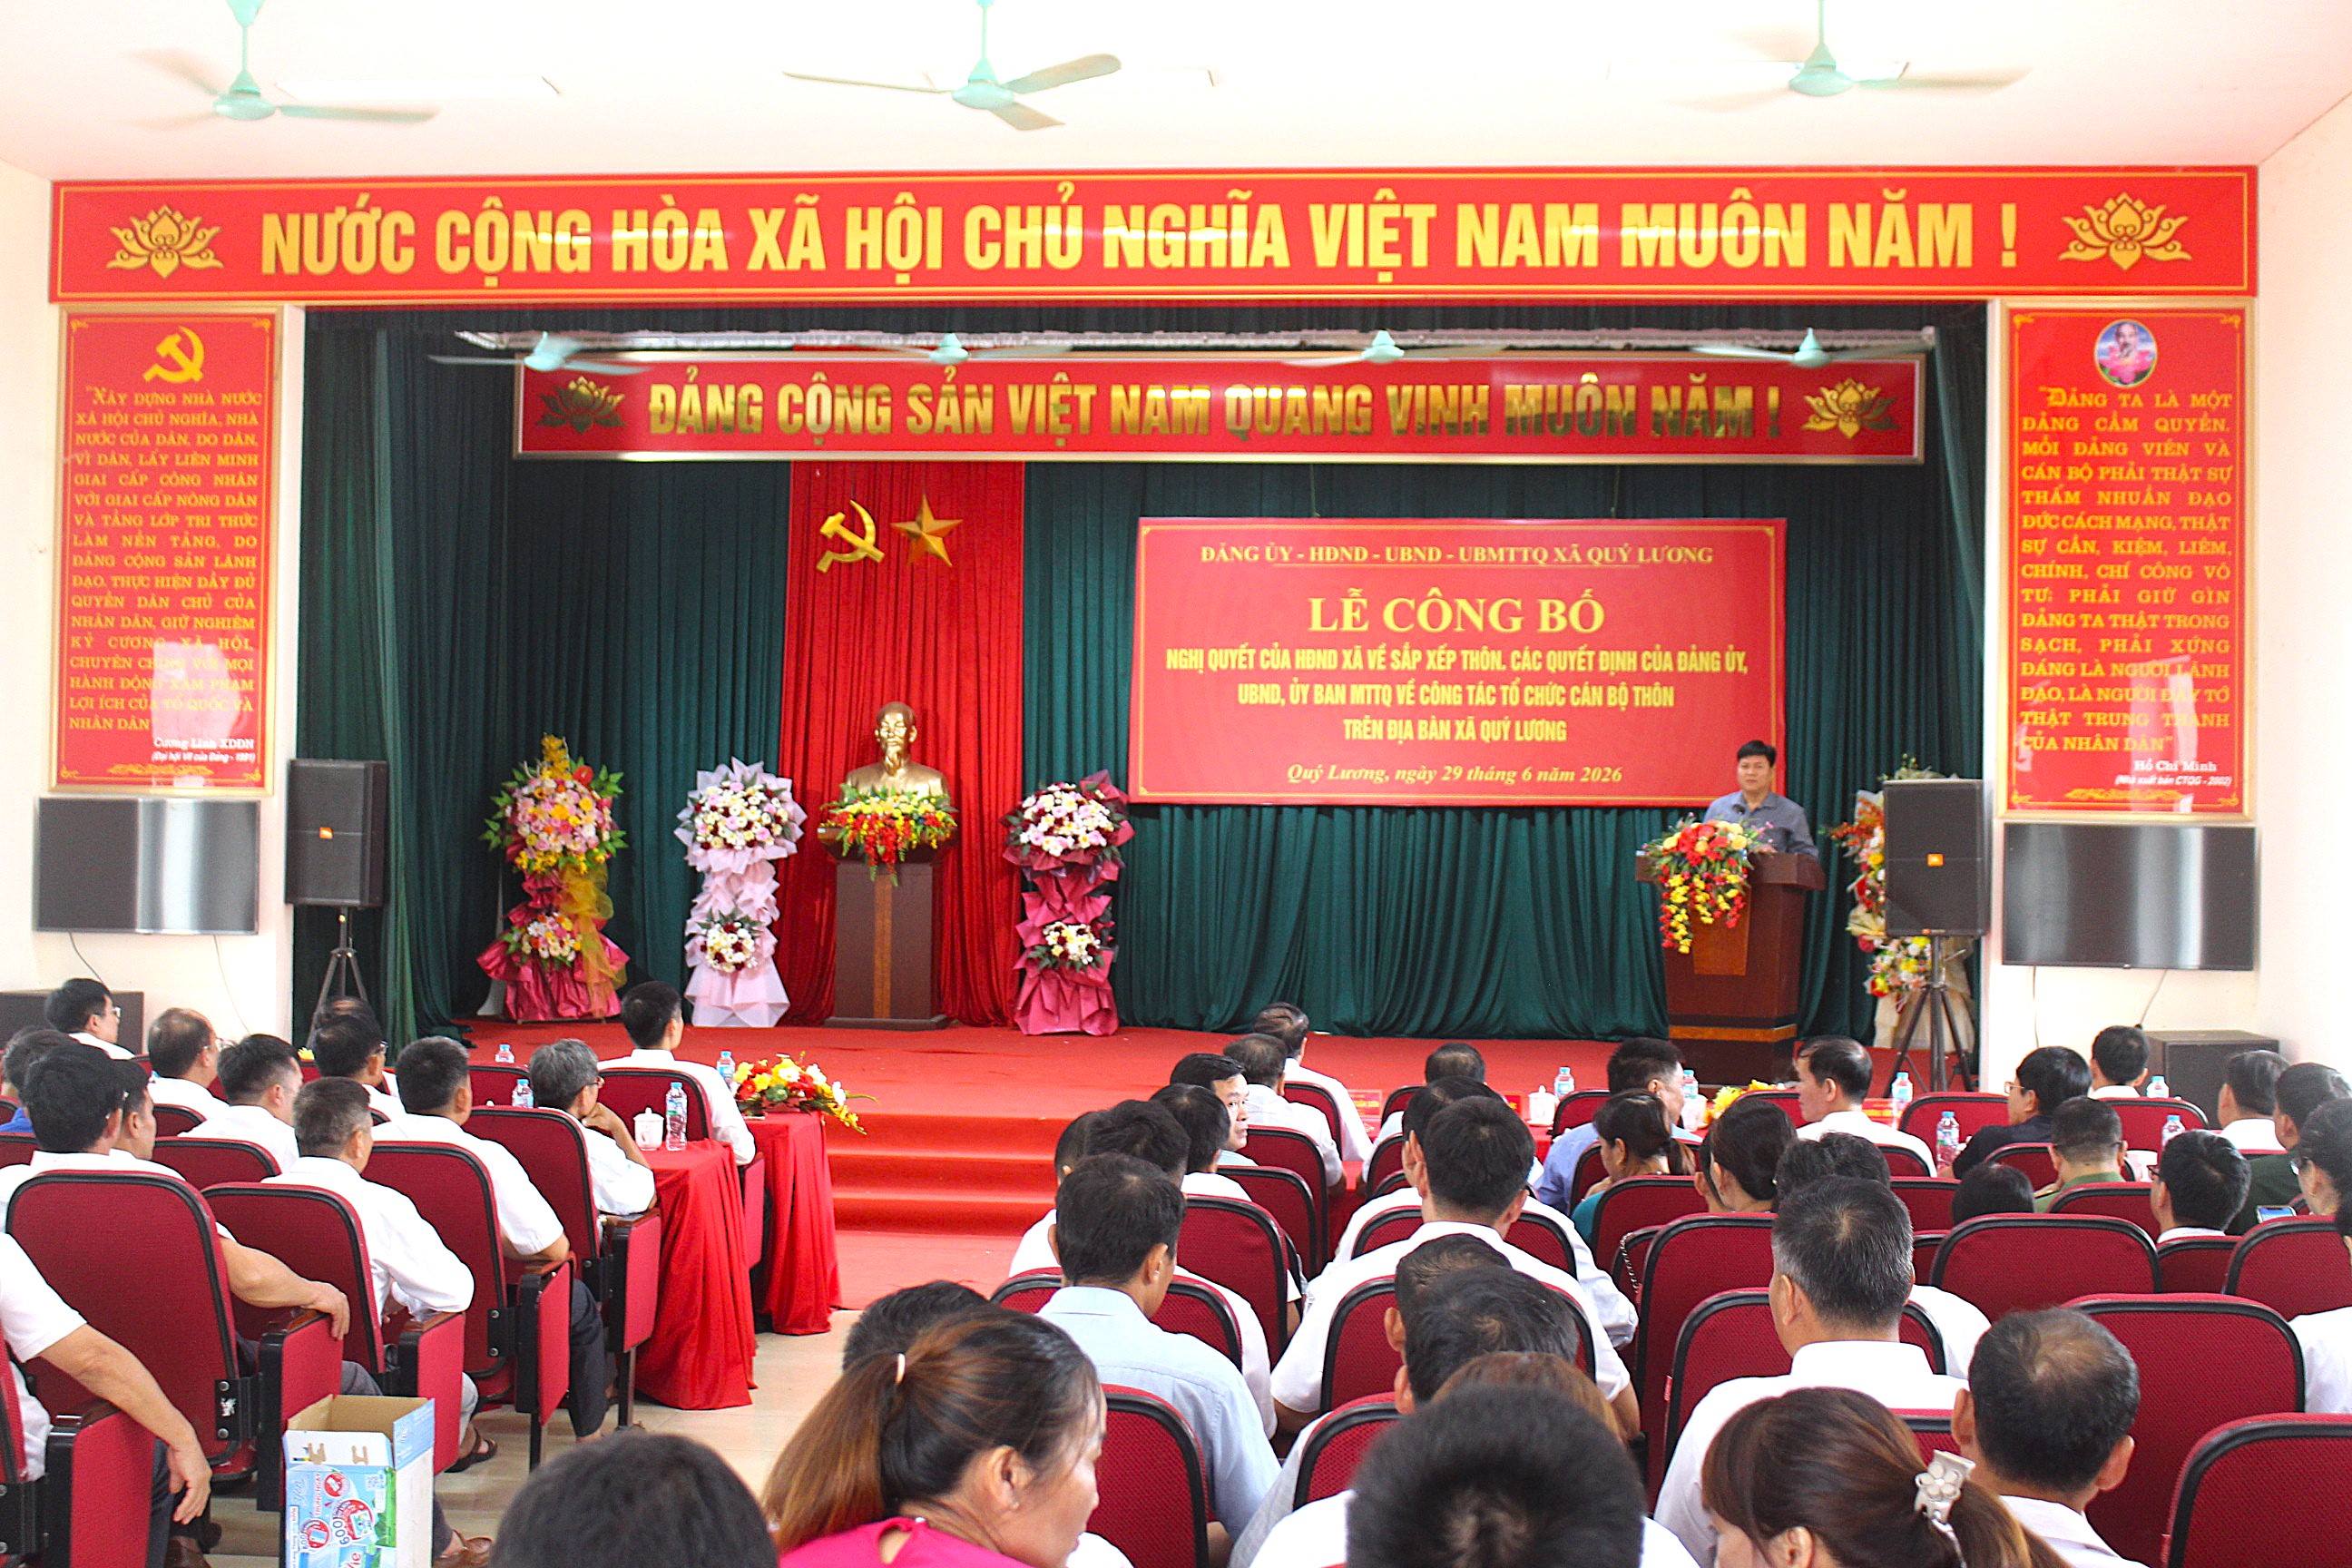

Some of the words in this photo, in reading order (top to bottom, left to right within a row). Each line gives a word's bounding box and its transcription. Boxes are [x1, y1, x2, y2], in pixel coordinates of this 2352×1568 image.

[262, 192, 415, 275] NƯỚC
[436, 195, 591, 287] CỘNG
[612, 194, 728, 272] HÒA
[748, 193, 826, 270] XÃ
[846, 191, 942, 285] HỘI
[964, 181, 1084, 270] CHỦ
[1103, 189, 1290, 270] NGHĨA
[1308, 188, 1437, 283] VIỆT
[1456, 202, 1599, 268] NAM
[1621, 187, 1807, 268] MUÔN
[1828, 188, 1974, 268] NĂM
[2001, 202, 2017, 268] !
[649, 366, 764, 436] ĐẢNG
[778, 372, 894, 446] CỘNG
[907, 366, 995, 436] SẢN
[1007, 372, 1098, 446] VIỆT
[1110, 385, 1211, 436] NAM
[1225, 385, 1373, 441] QUANG
[1386, 385, 1490, 436] VINH
[1504, 372, 1638, 437] MUÔN
[1651, 372, 1755, 438] NĂM
[1768, 386, 1781, 439] !
[2118, 394, 2142, 407] TA
[2154, 393, 2179, 407] LÀ
[2191, 392, 2231, 410] MỘT
[2023, 411, 2080, 431] ĐẢNG
[2093, 413, 2139, 432] CẦM
[2073, 436, 2128, 456] ĐẢNG
[2143, 440, 2189, 456] VIÊN
[2204, 443, 2230, 456] VÀ
[2022, 462, 2062, 480] CÁN
[2067, 463, 2094, 483] BỘ
[2099, 462, 2144, 480] PHẢI
[2151, 463, 2201, 483] THẬT
[2208, 466, 2233, 482] SỰ
[2022, 485, 2082, 505] THẤM
[2097, 486, 2171, 505] NHUẦN
[2188, 491, 2231, 508] ĐẠO
[2022, 511, 2059, 530] ĐỨC
[2062, 511, 2112, 530] CÁCH
[2181, 514, 2230, 532] THẬT
[1201, 544, 1259, 563] ĐẢNG
[1265, 542, 1292, 562] ỦY
[1309, 546, 1368, 562] HĐND
[1386, 546, 1442, 562] UBND
[1459, 546, 1548, 565] UBMTTQ
[1553, 544, 1582, 563] XÃ
[1637, 545, 1713, 564] LƯƠNG
[2096, 563, 2130, 579] CHÍ
[2140, 563, 2192, 579] CÔNG
[2205, 564, 2230, 580] VÔ
[2069, 584, 2120, 603] PHẢI
[2137, 587, 2176, 603] GIỮ
[2191, 589, 2230, 603] GÌN
[1309, 588, 1369, 632] LỄ
[1383, 587, 1524, 633] CÔNG
[1538, 588, 1605, 633] BỐ
[2022, 607, 2075, 628] ĐẢNG
[2081, 613, 2103, 628] TA
[2110, 610, 2160, 631] THẬT
[2163, 615, 2230, 629] TRONG
[2100, 633, 2151, 653] PHẢI
[2171, 638, 2230, 653] XỨNG
[1166, 648, 1204, 674] NGHỊ
[1208, 644, 1256, 671] QUYẾT
[1260, 642, 1291, 669] CỦA
[1295, 649, 1338, 671] HĐND
[1340, 645, 1364, 671] XÃ
[1367, 644, 1387, 671] VỀ
[1390, 643, 1423, 671] SẮP
[1426, 644, 1457, 671] XẾP
[1510, 646, 1543, 671] CÁC
[1546, 644, 1596, 672] QUYẾT
[1599, 650, 1637, 676] ĐỊNH
[1642, 644, 1673, 671] CỦA
[1678, 644, 1720, 672] ĐẢNG
[2021, 659, 2075, 677] ĐÁNG
[2081, 659, 2105, 677] LÀ
[1238, 683, 1286, 707] UBND,
[1289, 678, 1310, 704] ỦY
[1313, 684, 1347, 704] BAN
[1350, 683, 1393, 706] MTTQ
[1396, 679, 1415, 705] VỀ
[1418, 681, 1464, 706] CÔNG
[1466, 682, 1496, 706] TÁC
[1500, 678, 1521, 706] TỔ
[1524, 682, 1568, 706] CHỨC
[1569, 683, 1604, 707] CÁN
[1606, 682, 1630, 710] BỘ
[1632, 682, 1675, 707] THÔN
[2020, 709, 2073, 729] THẬT
[2083, 711, 2149, 727] TRUNG
[1344, 717, 1384, 740] TRÊN
[1387, 719, 1414, 744] ĐỊA
[1418, 716, 1452, 740] BÀN
[1455, 717, 1477, 740] XÃ
[1480, 718, 1511, 743] QUÝ
[1513, 719, 1567, 742] LƯƠNG
[2021, 730, 2058, 750] CỦA
[2063, 733, 2118, 751] NHÂN
[1288, 765, 1323, 784] Quý
[1328, 765, 1388, 784] Lương,
[1396, 767, 1436, 784] ngày
[1441, 766, 1464, 781] 29
[1466, 766, 1516, 785] tháng
[1521, 768, 1533, 781] 6
[1536, 767, 1575, 782] năm
[1581, 767, 1622, 783] 2026
